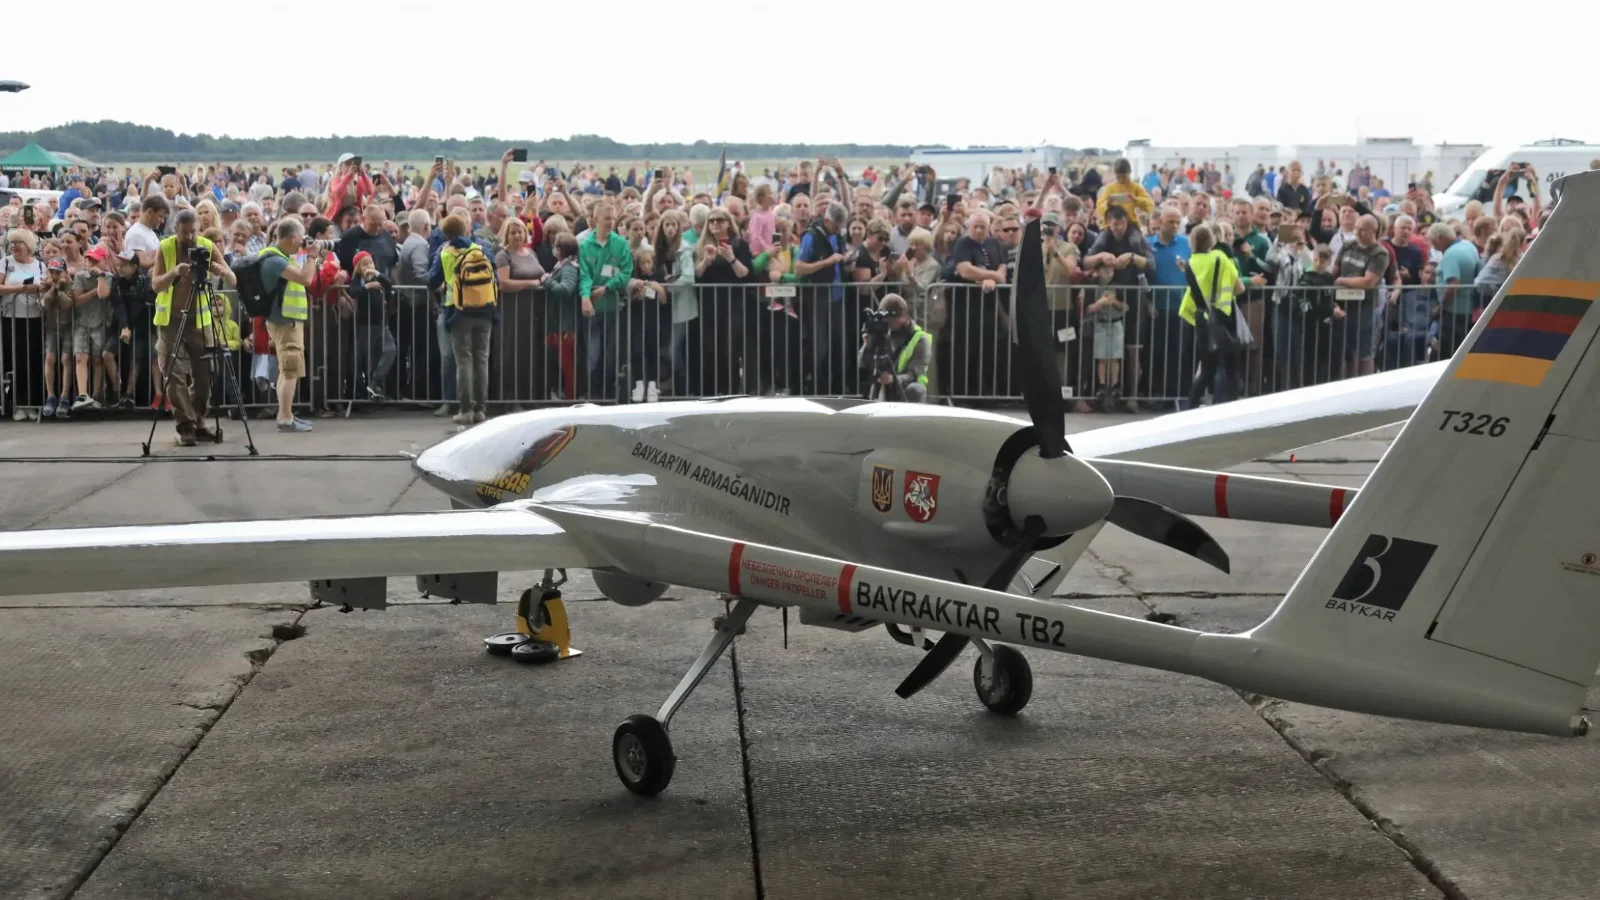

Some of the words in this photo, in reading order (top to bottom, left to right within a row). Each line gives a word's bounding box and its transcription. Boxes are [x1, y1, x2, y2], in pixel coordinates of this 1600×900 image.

[1439, 410, 1510, 437] T326
[690, 465, 791, 516] ARMAĞANIDIR
[750, 574, 780, 589] DANGER
[782, 582, 827, 600] PROPELLER
[857, 581, 1001, 635] BAYRAKTAR
[1015, 612, 1066, 648] TB2
[1325, 599, 1396, 622] BAYKAR
